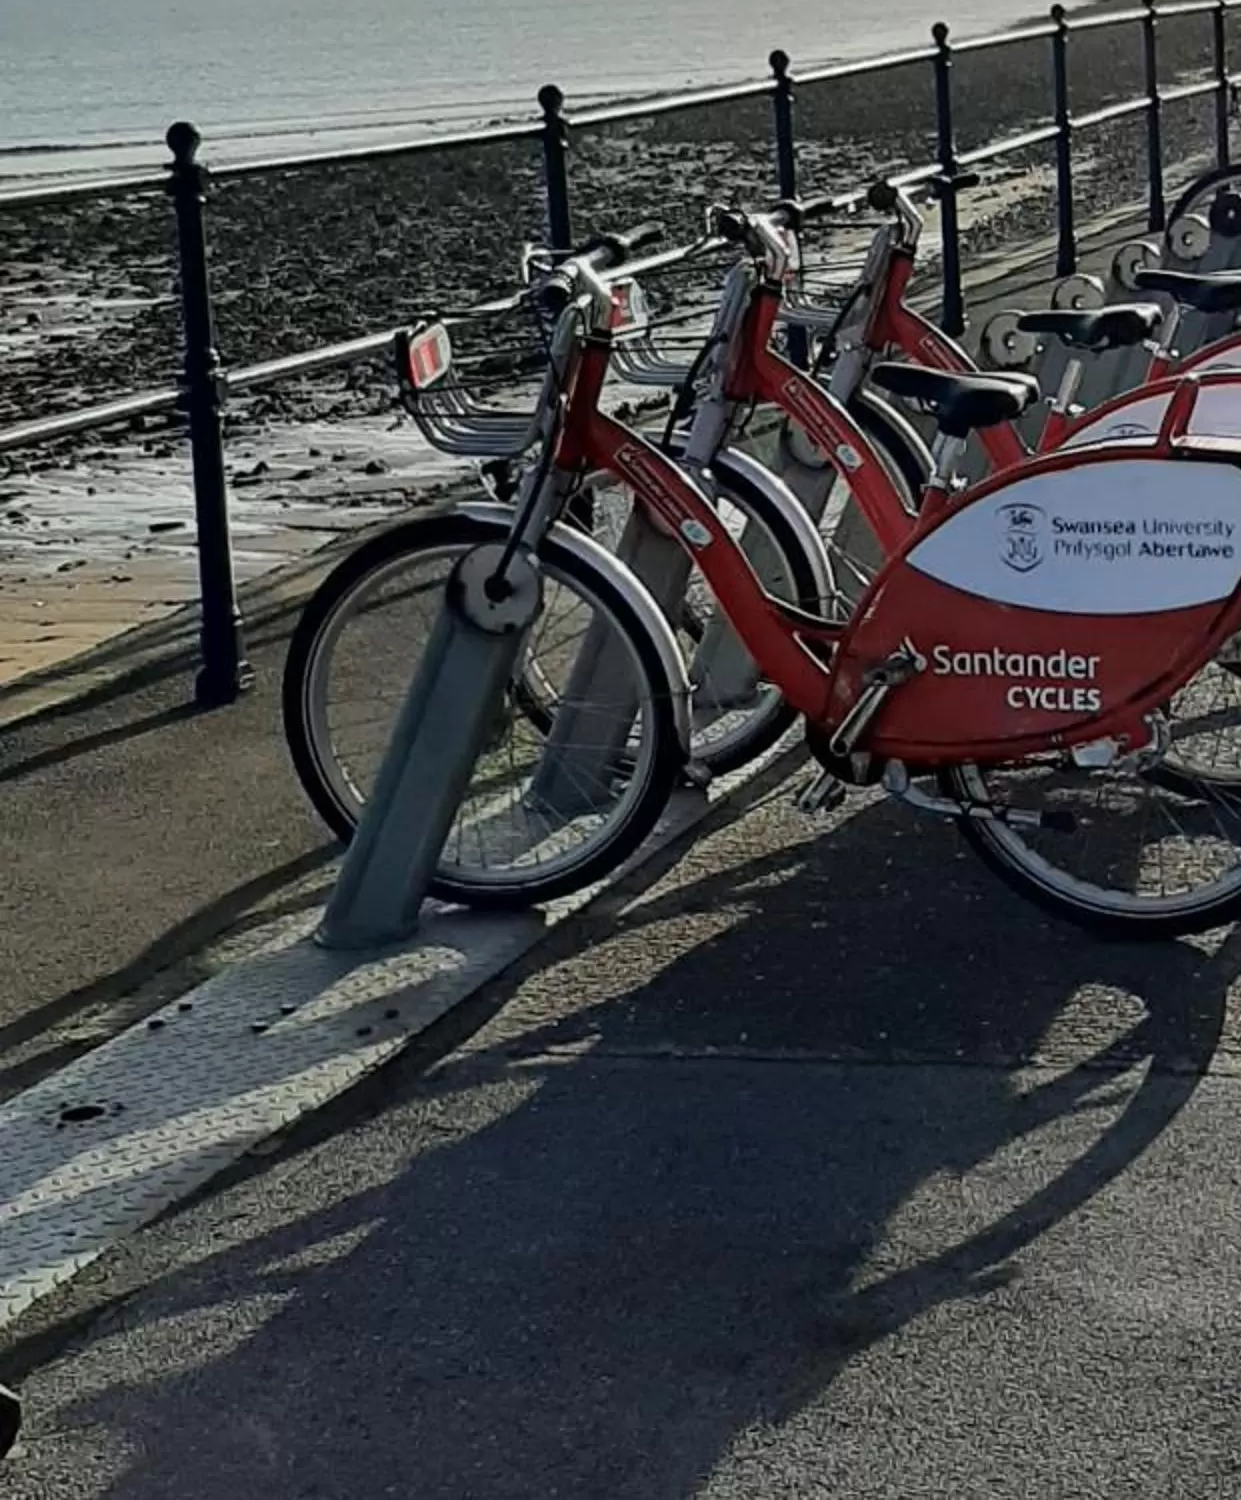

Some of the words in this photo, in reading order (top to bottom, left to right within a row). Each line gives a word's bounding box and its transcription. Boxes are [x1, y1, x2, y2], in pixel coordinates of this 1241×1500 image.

[1052, 516, 1136, 535] Swansea
[1143, 517, 1236, 538] University
[1054, 538, 1132, 561] Prifysgol
[1138, 540, 1235, 559] Abertawe
[932, 645, 1101, 680] Santander
[1007, 685, 1102, 712] CYCLES
